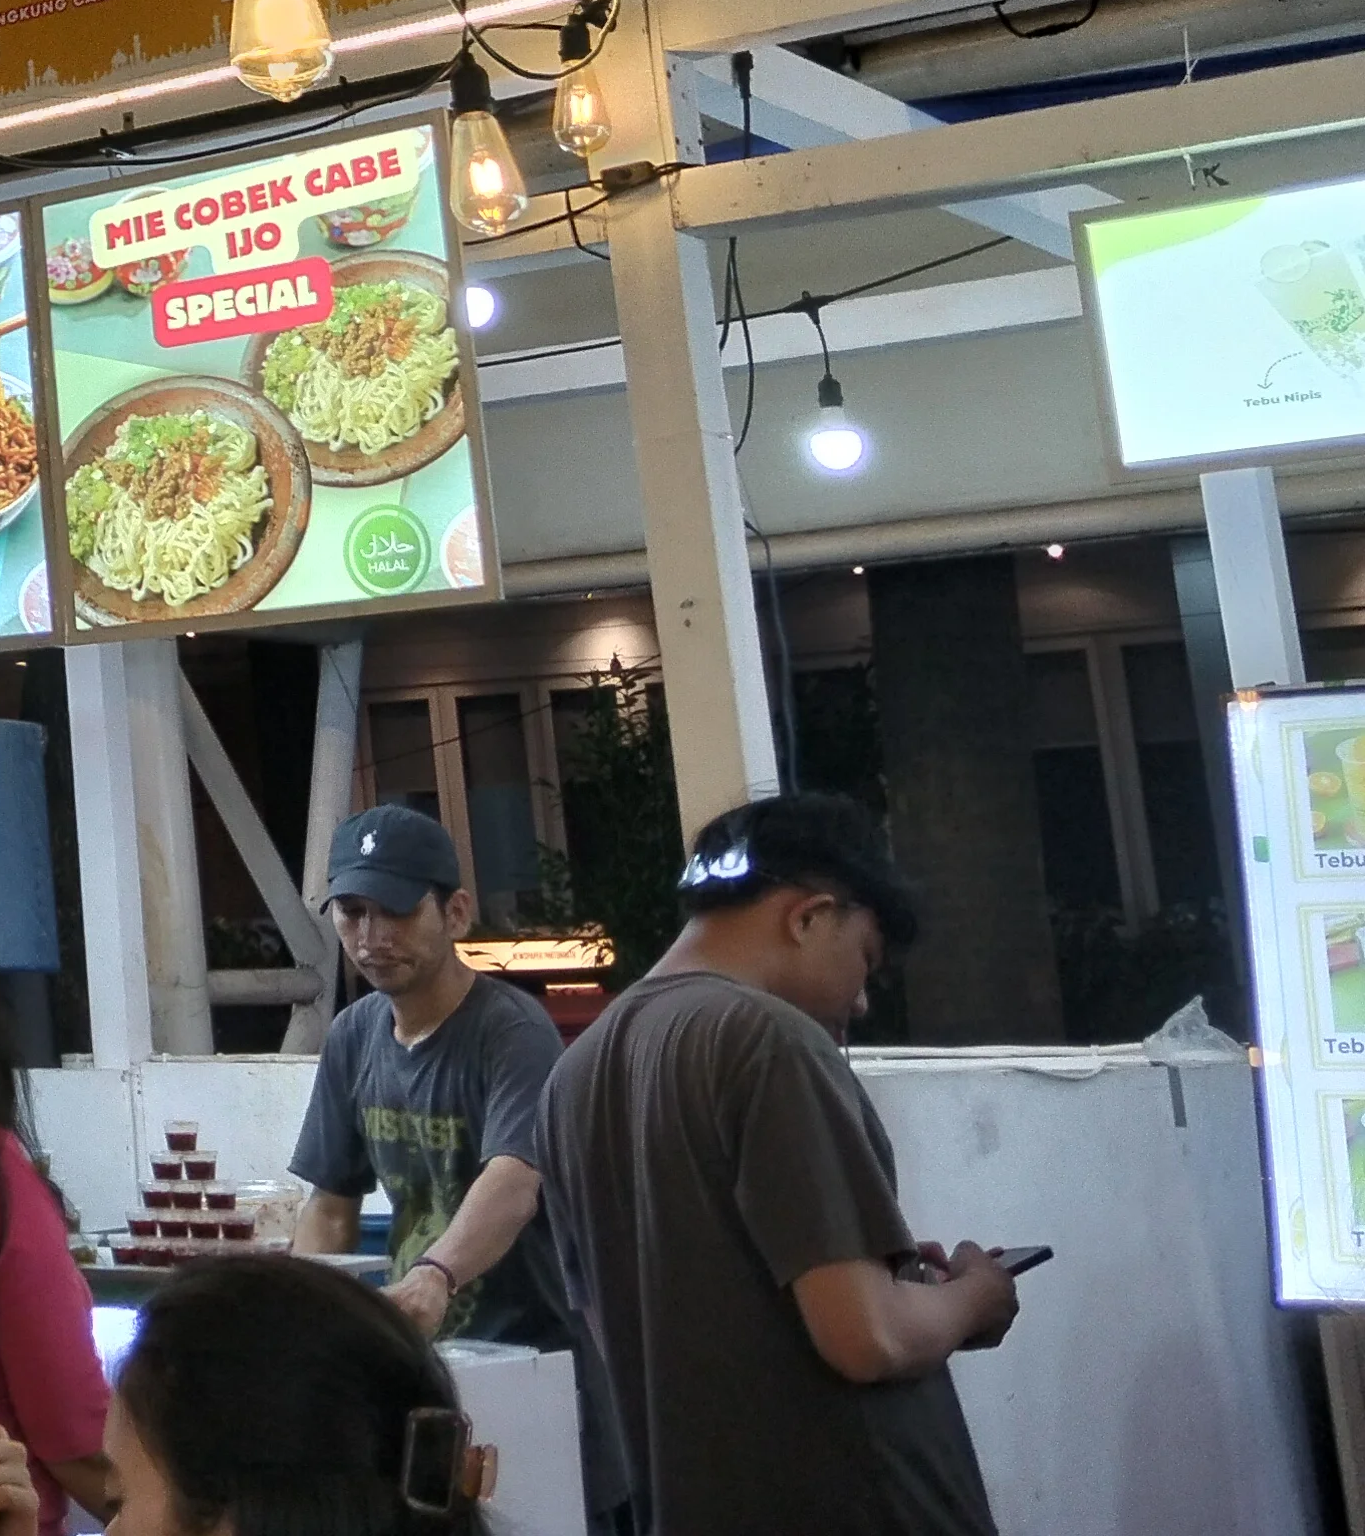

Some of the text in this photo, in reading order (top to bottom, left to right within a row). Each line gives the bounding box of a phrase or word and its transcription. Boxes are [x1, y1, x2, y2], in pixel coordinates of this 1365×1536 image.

[104, 148, 403, 251] MIE COBEK CABE
[226, 221, 282, 260] IJO
[165, 274, 318, 330] SPECIAL
[1242, 389, 1322, 408] Tebu Nipis
[359, 535, 415, 561] حلال
[367, 558, 410, 574] HALAL
[1314, 850, 1365, 869] Tebu
